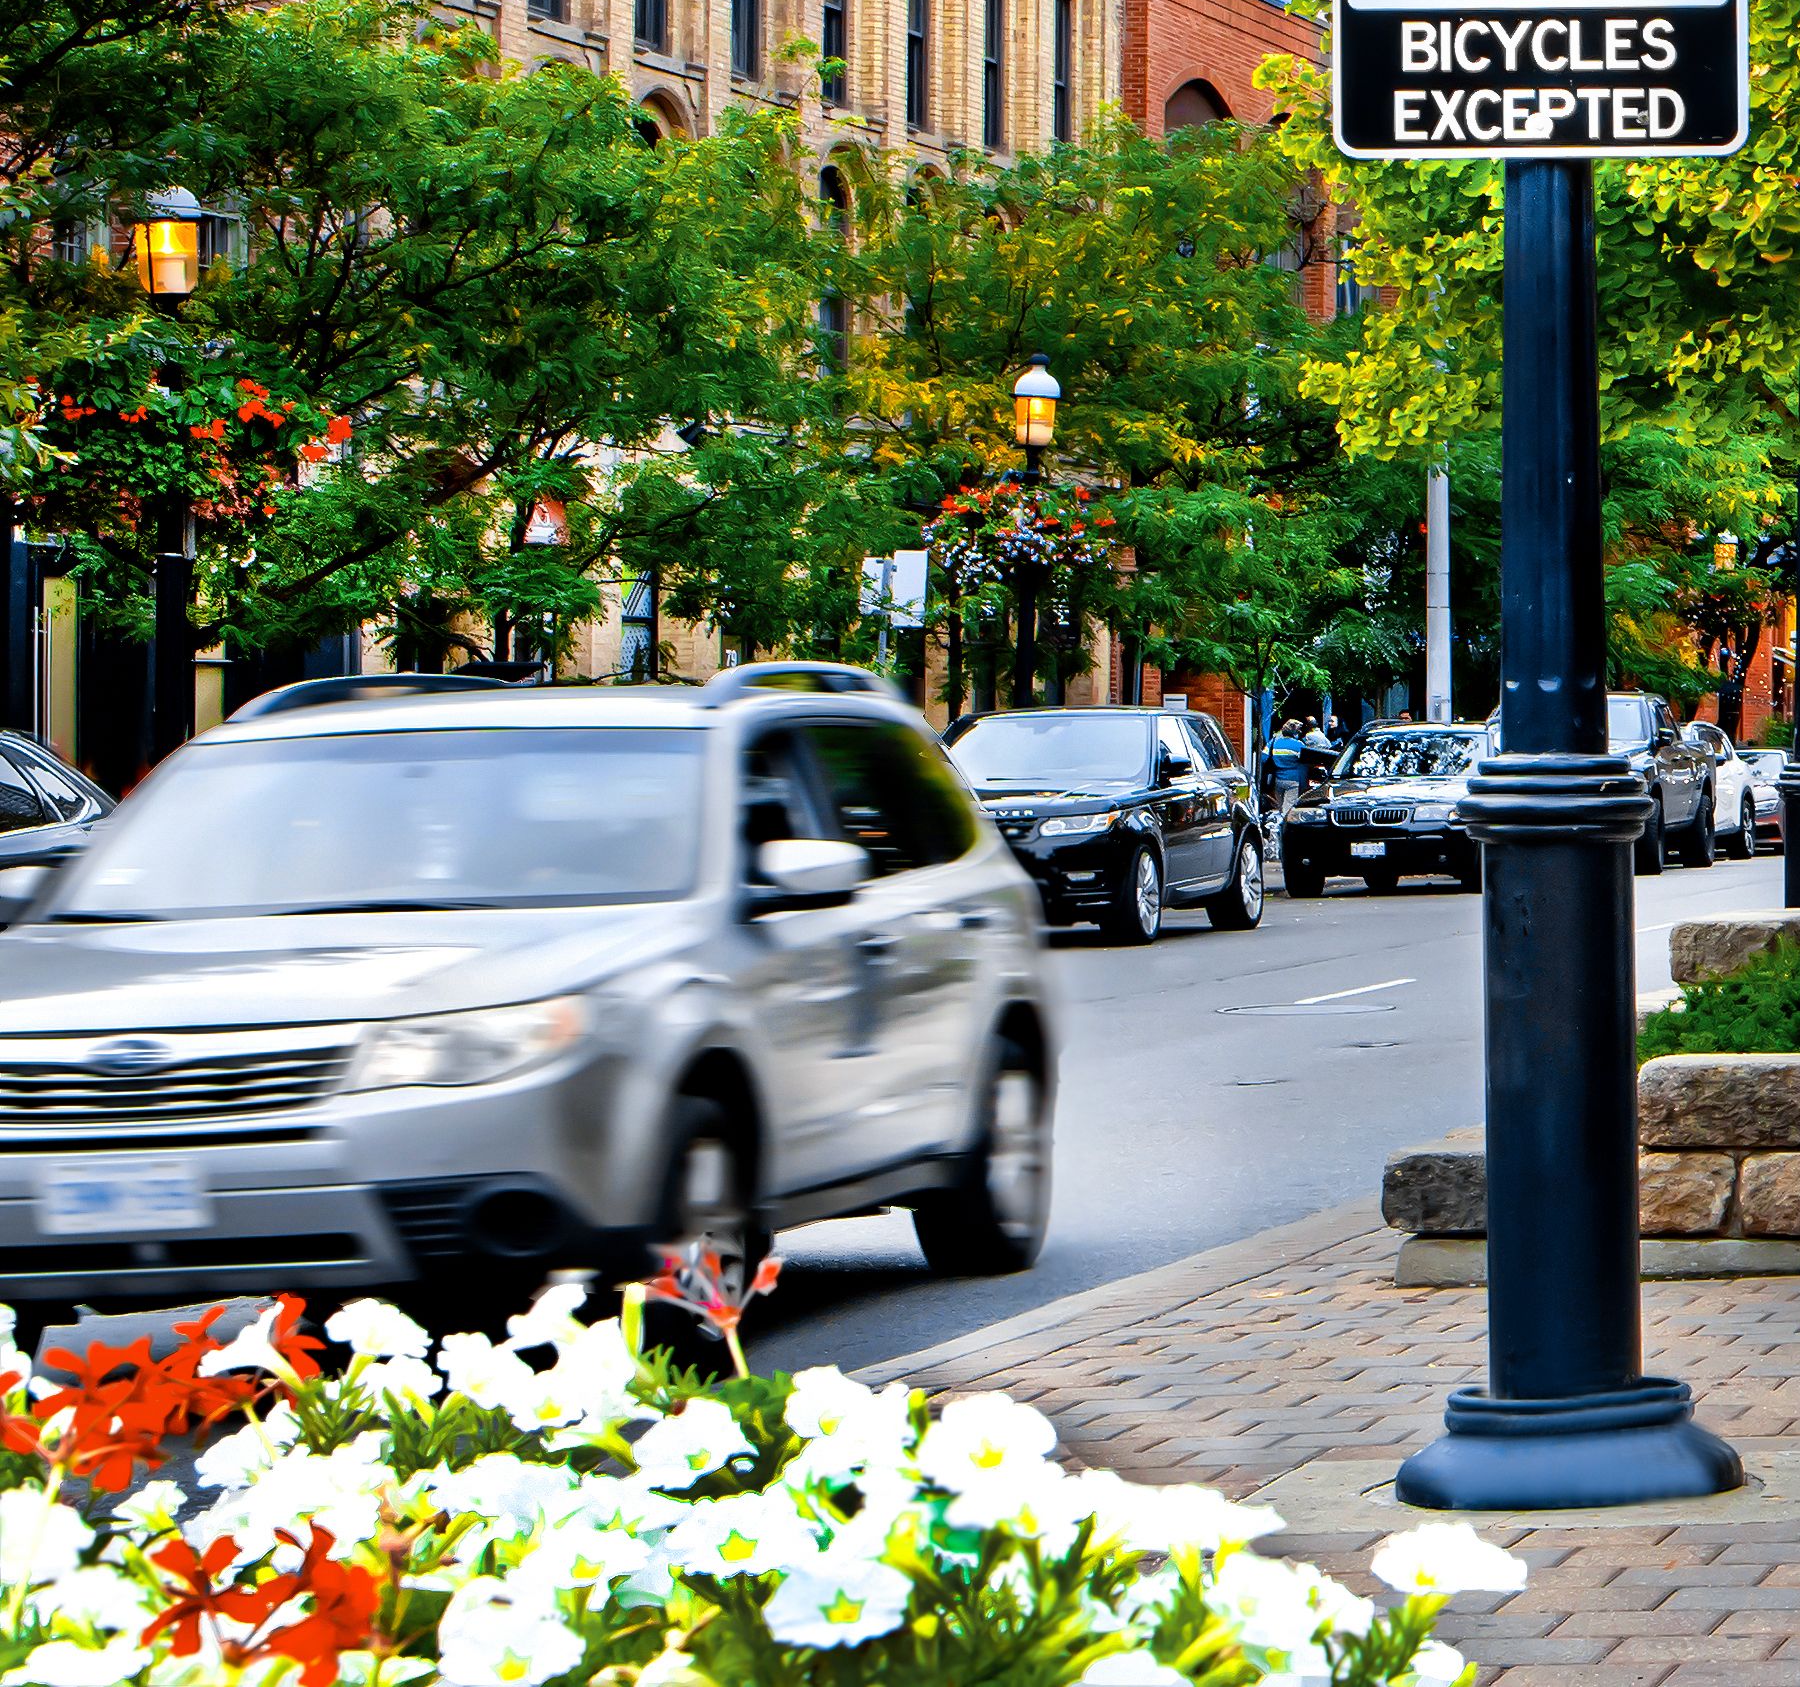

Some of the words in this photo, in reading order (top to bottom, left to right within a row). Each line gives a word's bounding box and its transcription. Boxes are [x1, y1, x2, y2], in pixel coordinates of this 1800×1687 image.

[1401, 18, 1677, 73] BICYCLES
[1393, 87, 1687, 142] EXCEPTED
[725, 649, 738, 668] 79
